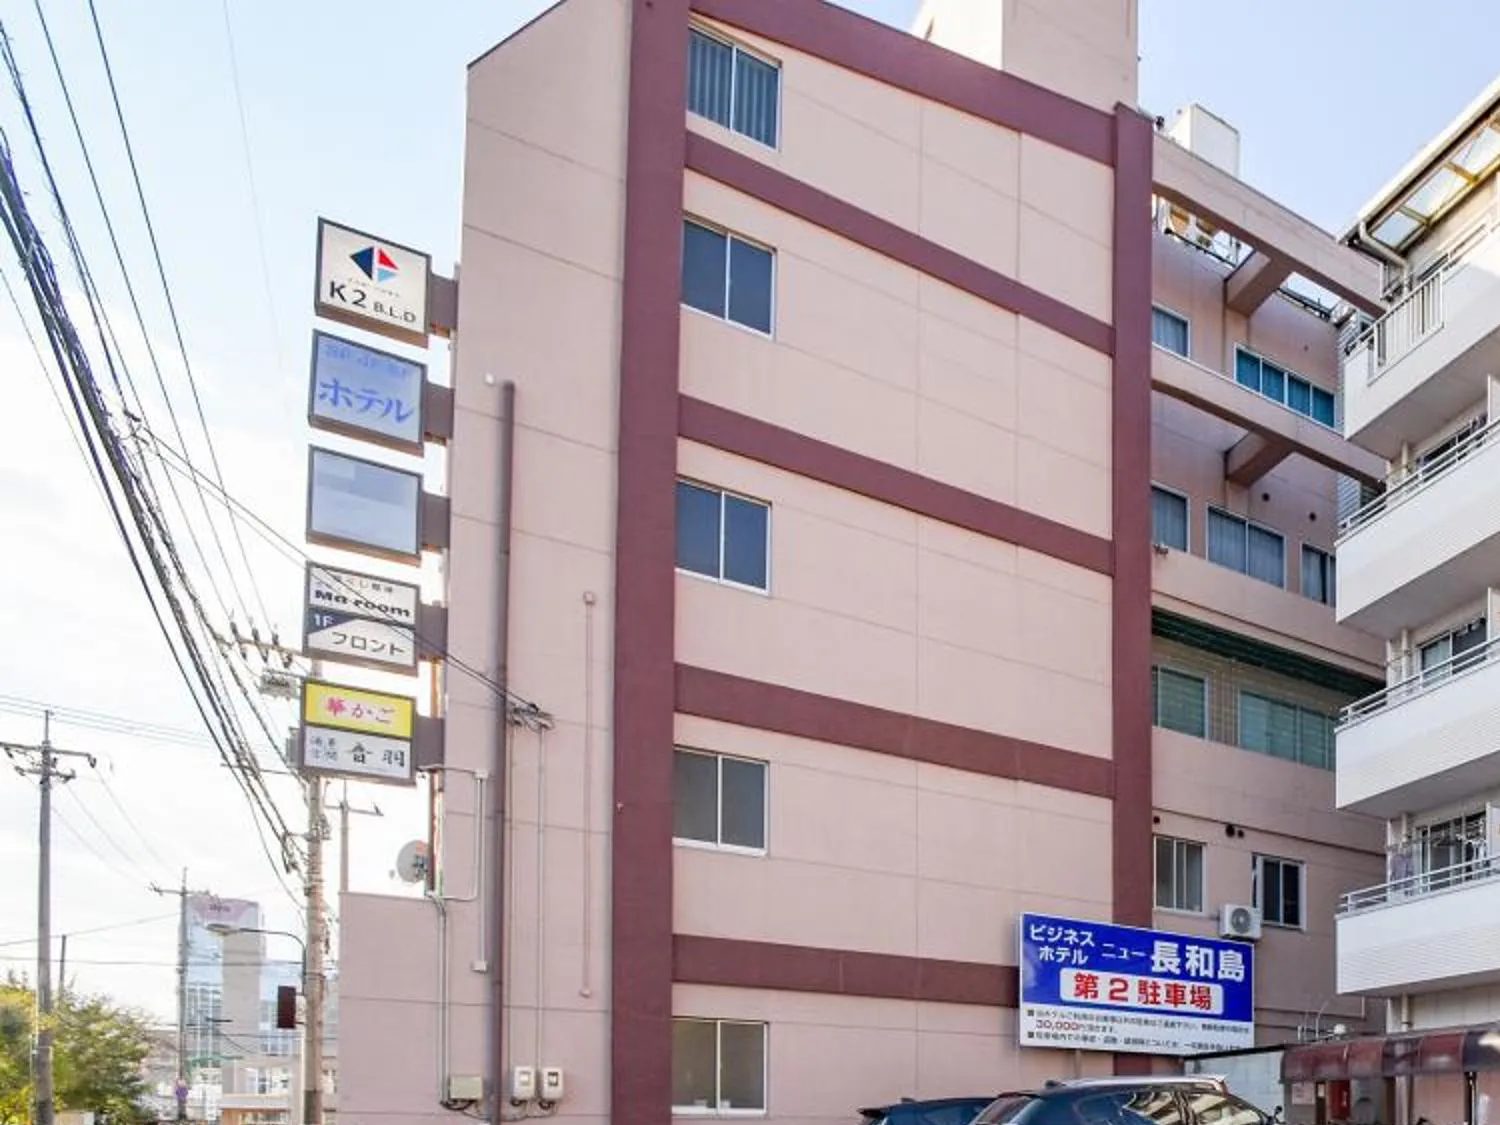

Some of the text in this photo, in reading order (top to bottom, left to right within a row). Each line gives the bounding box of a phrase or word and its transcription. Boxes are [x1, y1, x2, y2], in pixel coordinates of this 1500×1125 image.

[330, 280, 367, 308] K2
[318, 377, 415, 423] ホテル
[331, 631, 405, 656] フロント
[1030, 924, 1096, 948] ビジネス
[1038, 945, 1089, 966] ホテル
[1073, 972, 1211, 1011] 第2駐車場
